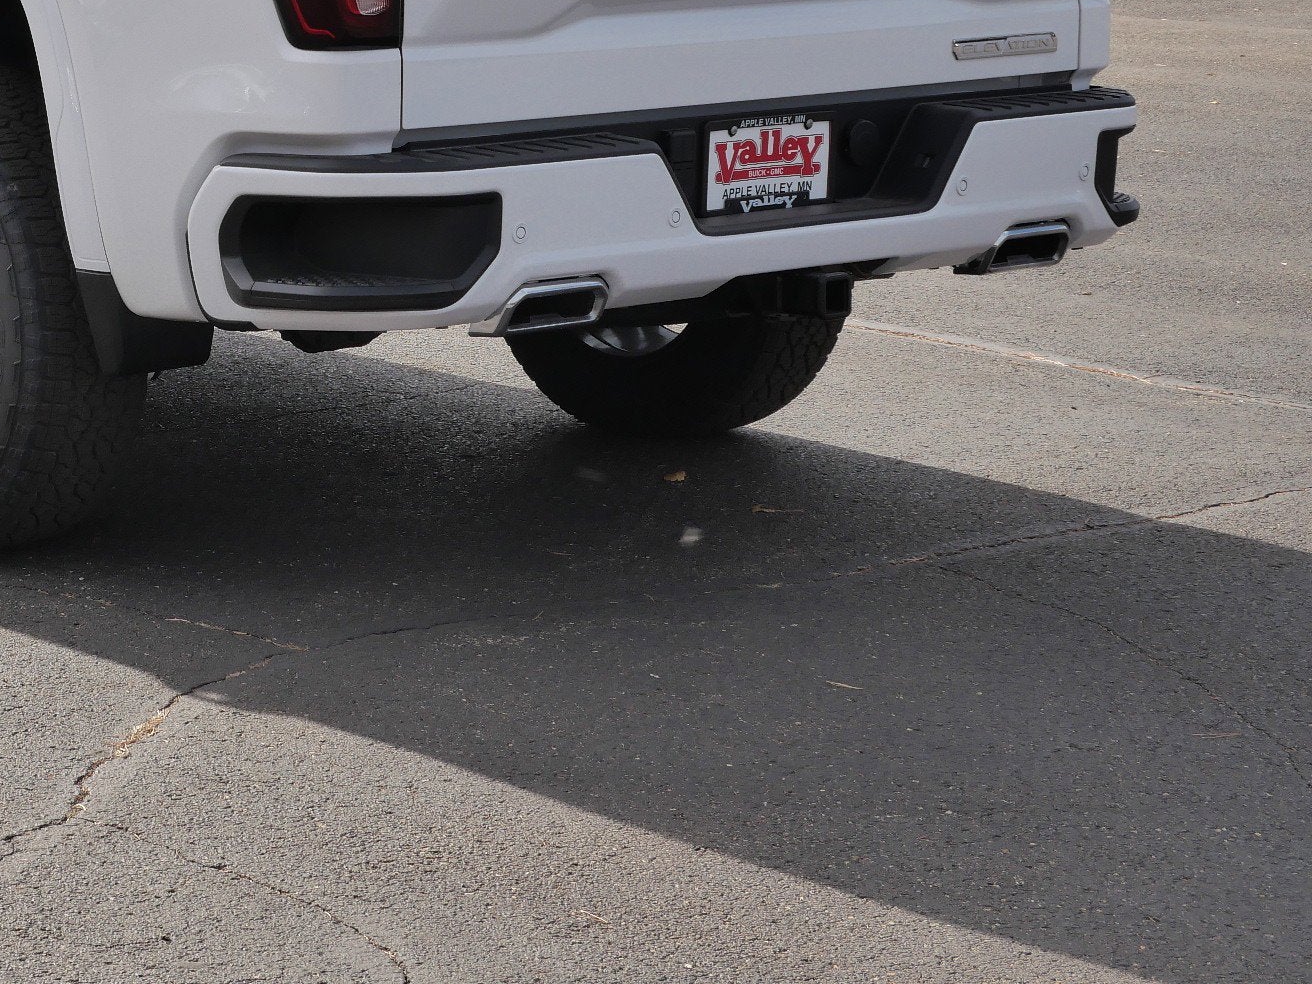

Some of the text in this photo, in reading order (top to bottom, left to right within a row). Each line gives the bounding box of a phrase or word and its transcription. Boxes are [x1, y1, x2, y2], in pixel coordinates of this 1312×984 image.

[740, 118, 764, 128] APPLE
[795, 115, 806, 123] MN
[715, 128, 824, 185] Valley
[748, 167, 784, 178] BUICK GMC
[722, 185, 752, 200] APPLE
[797, 180, 812, 191] MN
[739, 194, 797, 213] Valley
